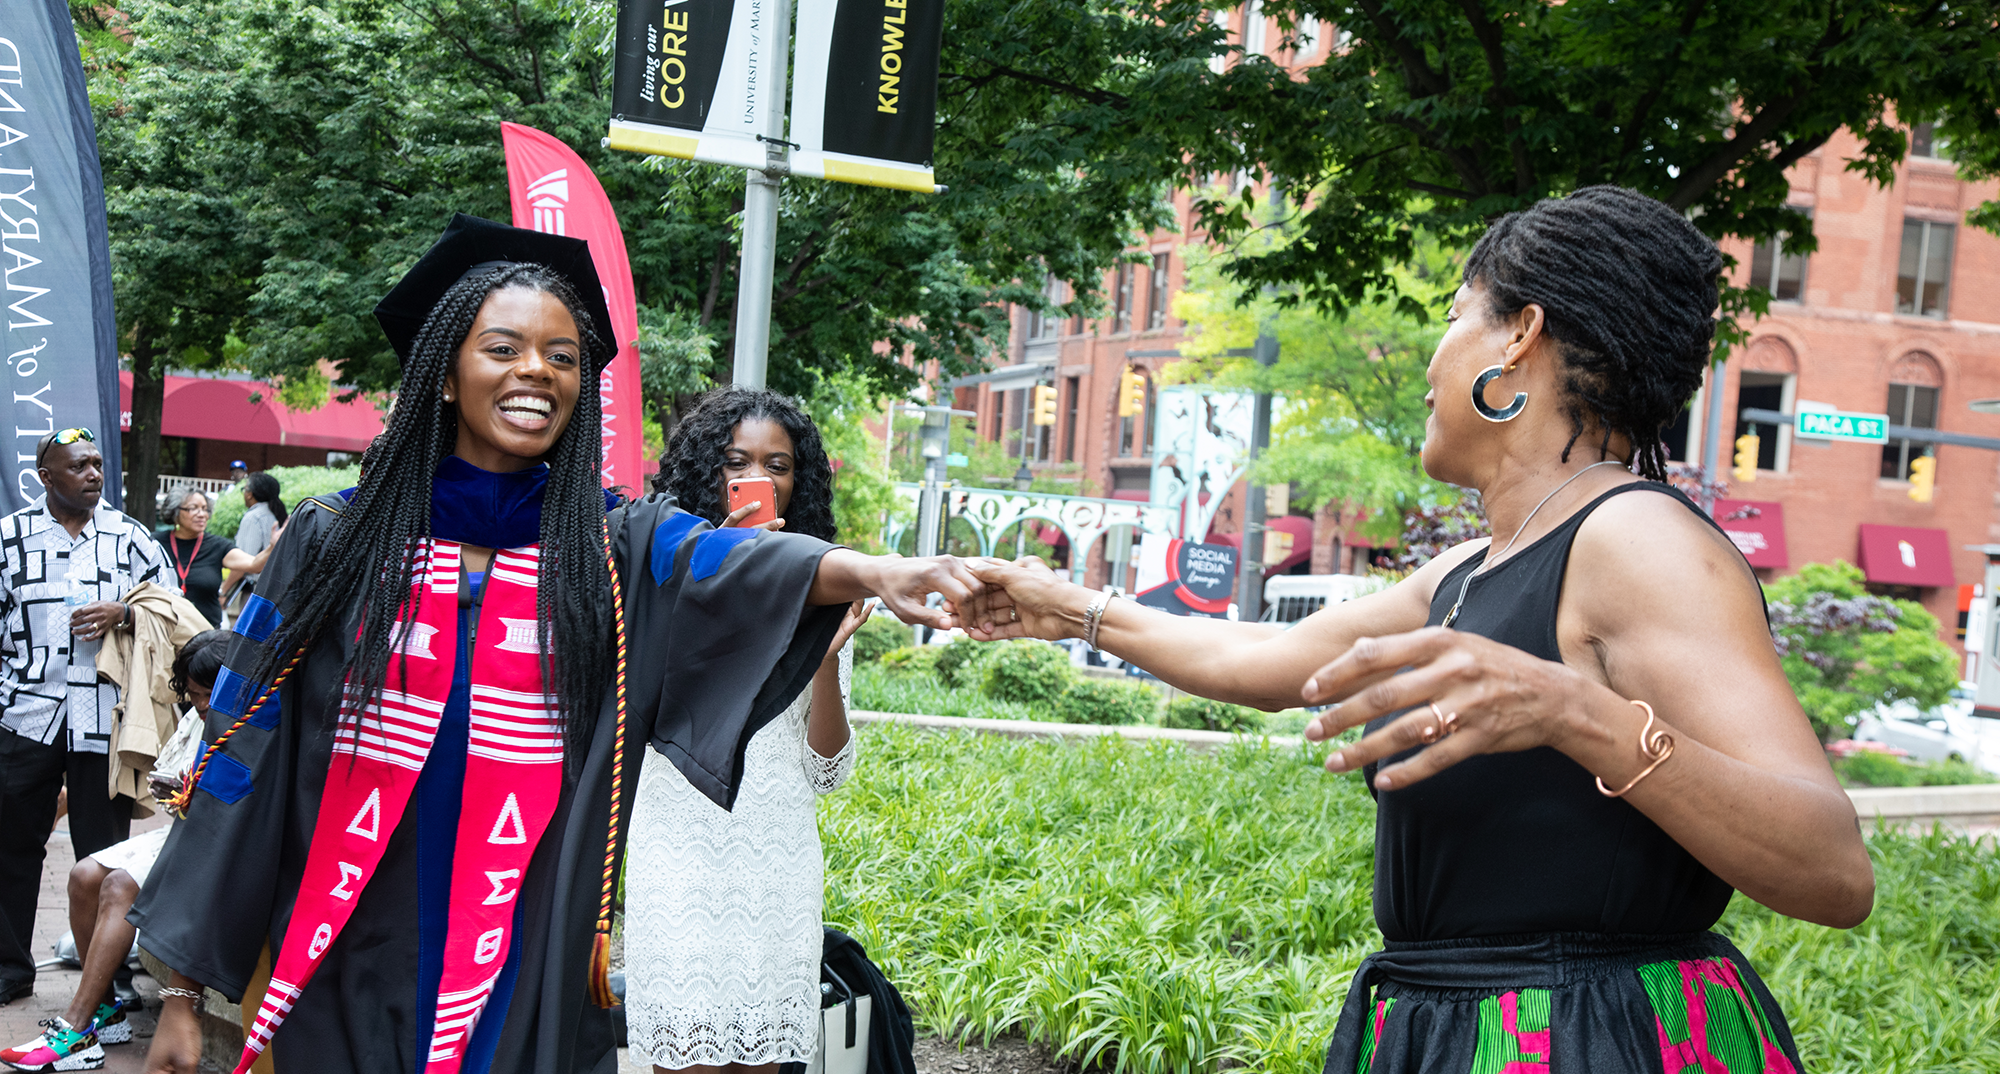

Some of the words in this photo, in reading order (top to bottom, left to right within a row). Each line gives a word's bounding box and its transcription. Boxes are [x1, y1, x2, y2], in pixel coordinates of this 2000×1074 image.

[750, 0, 761, 31] MAR
[647, 23, 658, 53] our
[752, 32, 761, 46] of
[660, 8, 689, 109] CORE
[640, 54, 661, 103] living
[744, 49, 759, 124] UNIVERSITY
[1803, 414, 1855, 436] PACA
[1186, 558, 1226, 575] MEDIA
[1188, 547, 1233, 565] SOCIAL
[1186, 570, 1222, 589] Lounge
